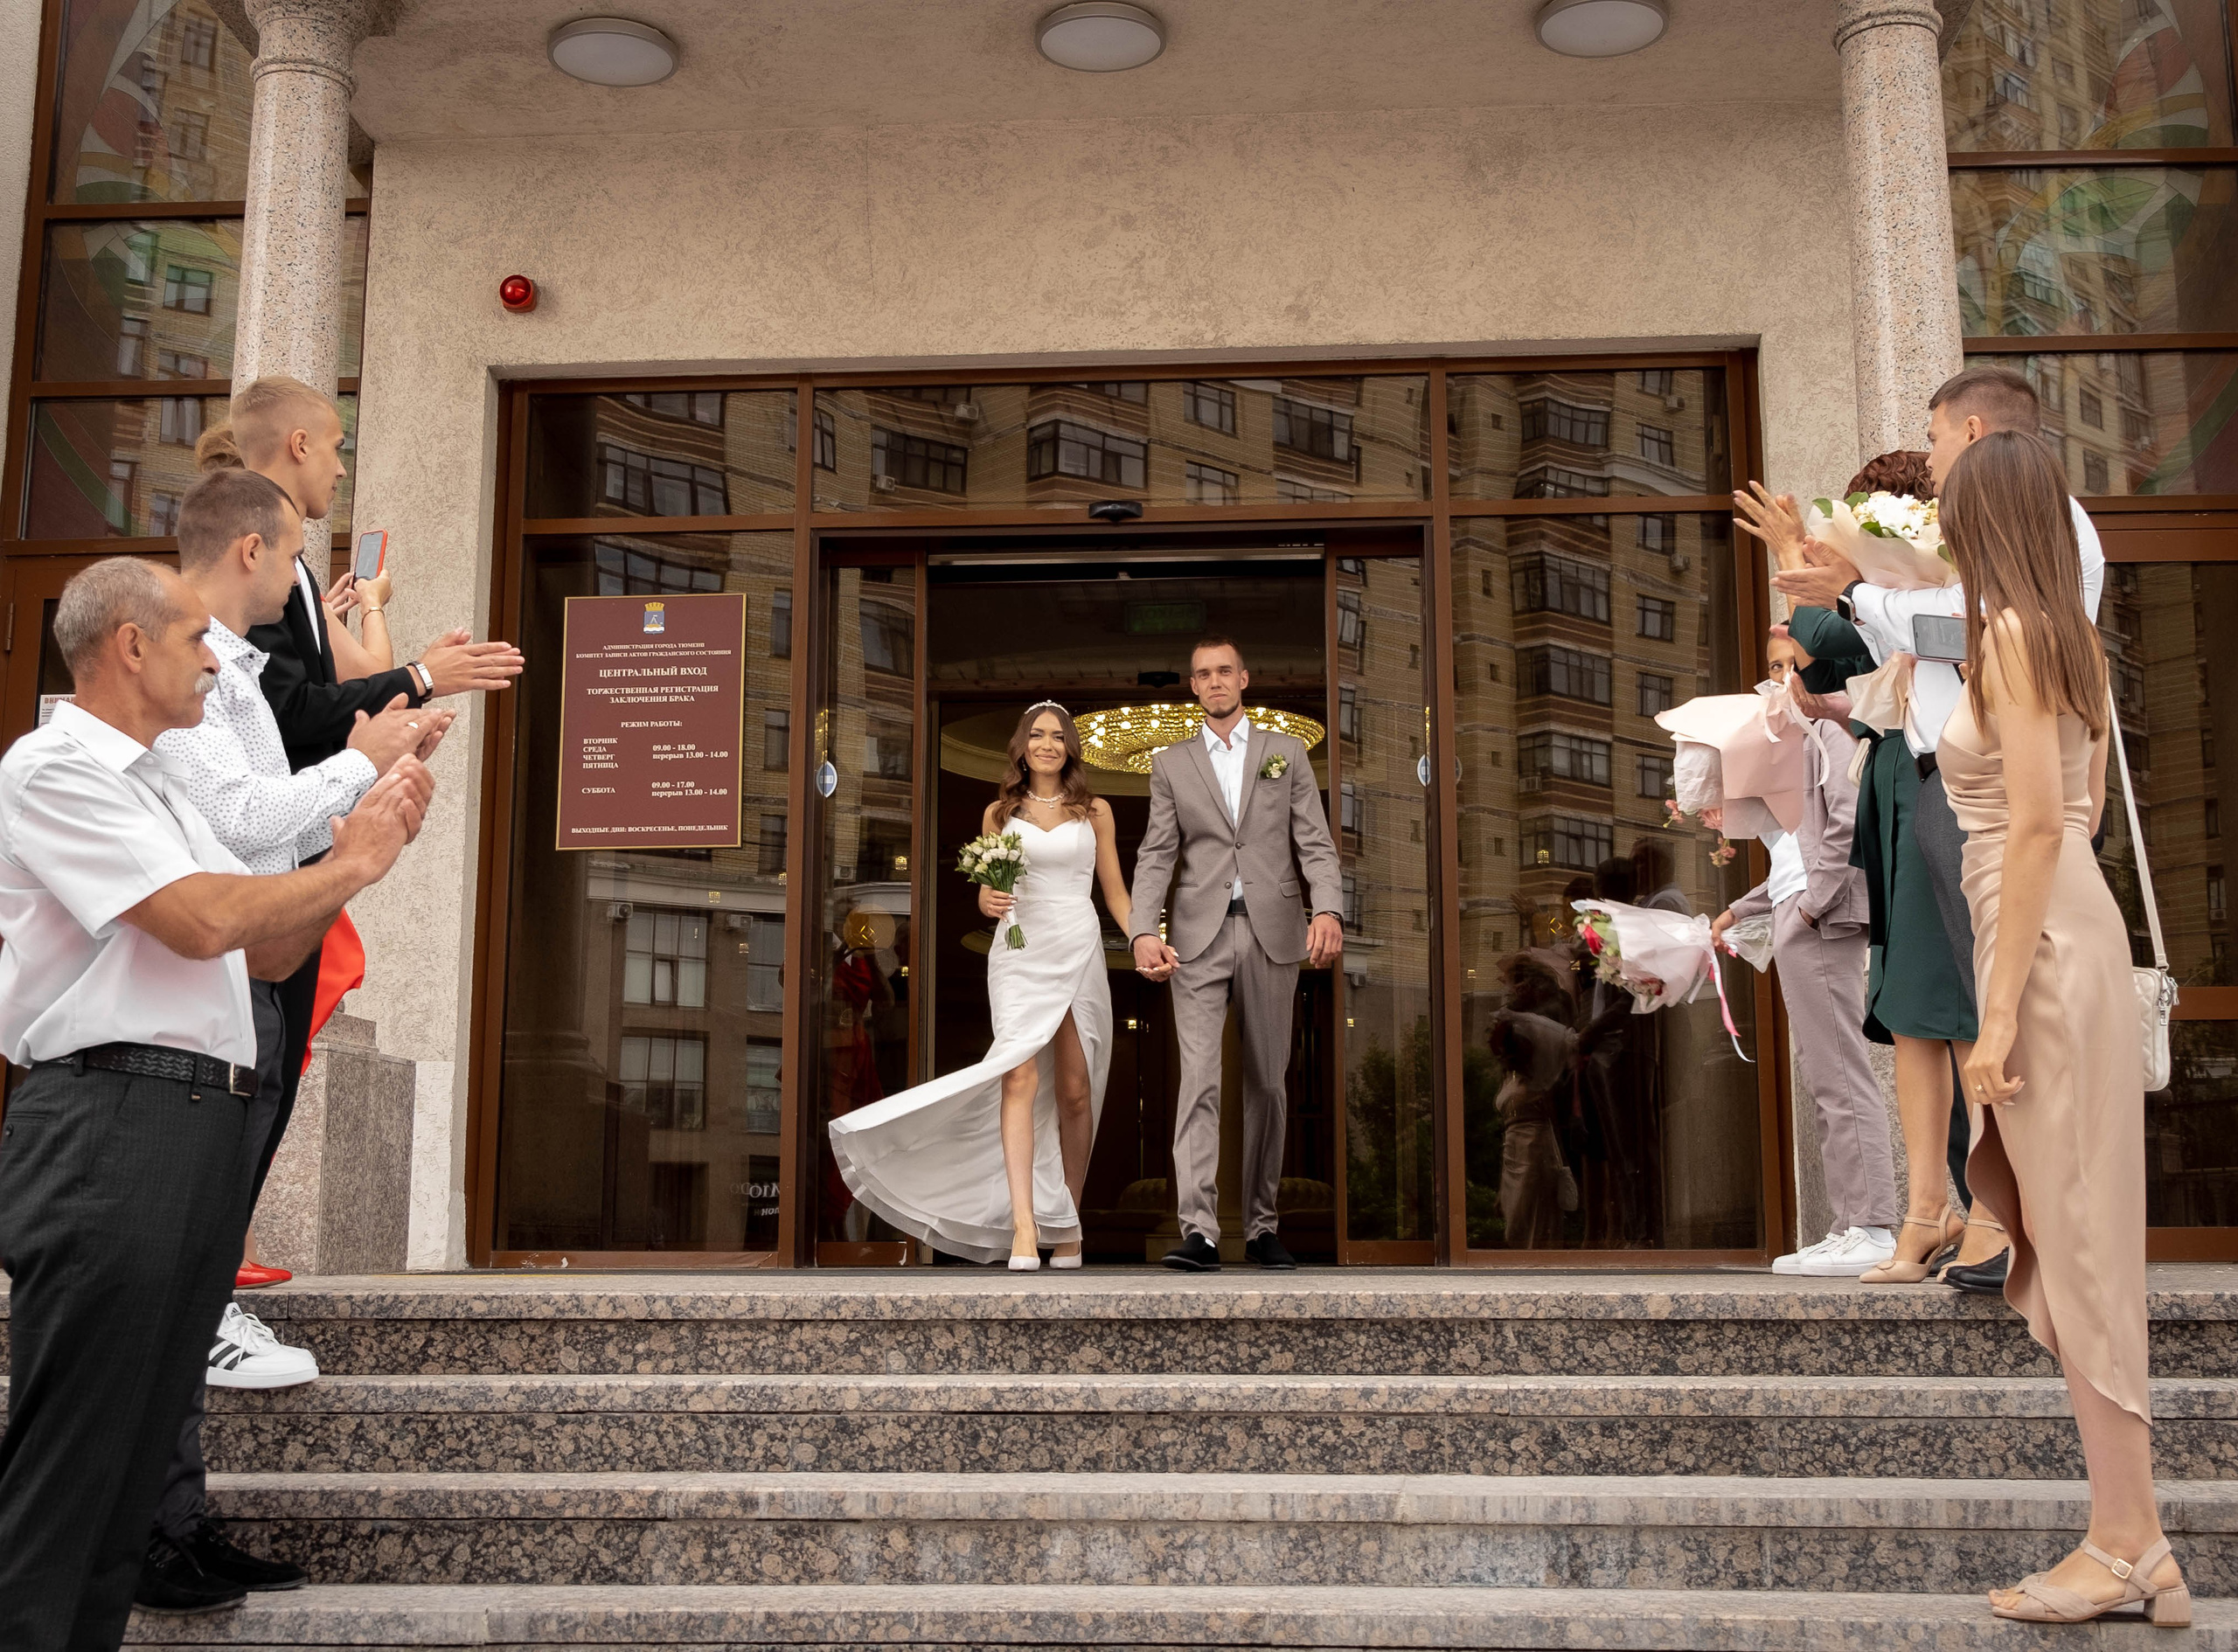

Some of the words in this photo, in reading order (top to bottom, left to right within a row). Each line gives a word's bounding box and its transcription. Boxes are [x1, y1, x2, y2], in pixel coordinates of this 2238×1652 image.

[600, 666, 678, 678] ЦЕНТРАЛЬНЫЙ
[680, 667, 707, 677] ВХОД
[660, 685, 719, 694] РЕГИСТРАЦИЯ
